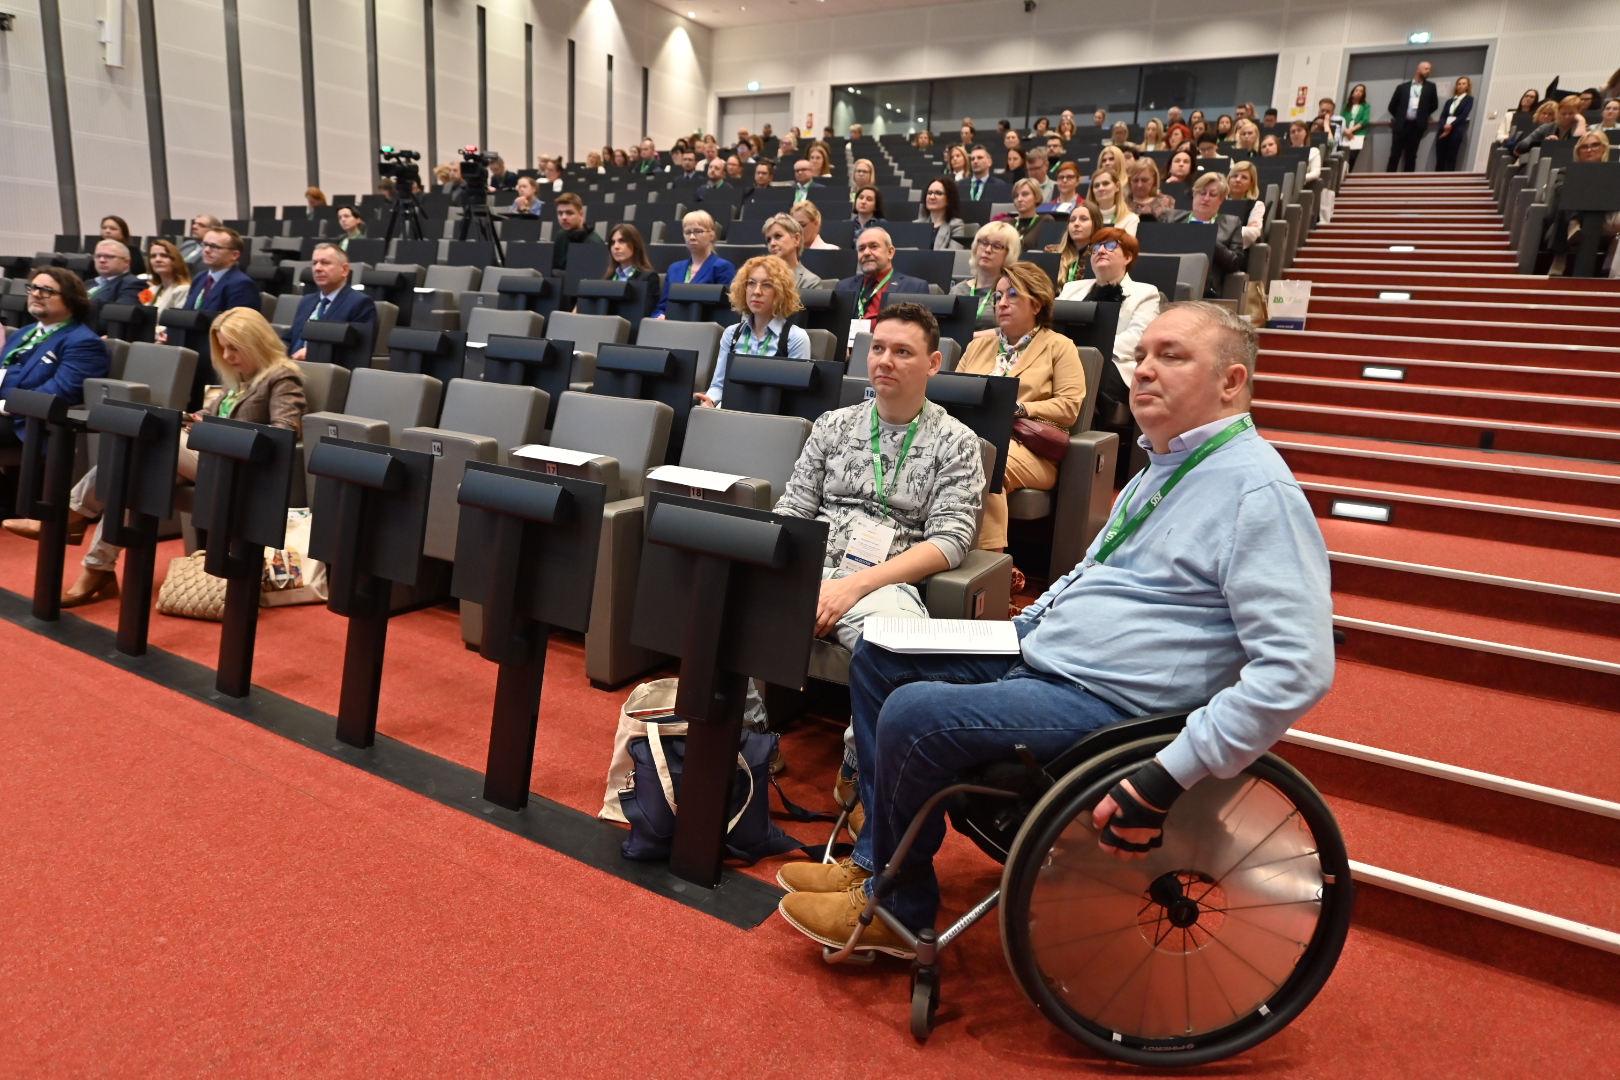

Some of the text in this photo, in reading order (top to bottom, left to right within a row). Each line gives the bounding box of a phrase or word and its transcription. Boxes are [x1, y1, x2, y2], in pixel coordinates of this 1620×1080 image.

[866, 390, 875, 398] 18
[433, 444, 442, 453] 16
[546, 465, 557, 475] 17
[690, 488, 702, 498] 18
